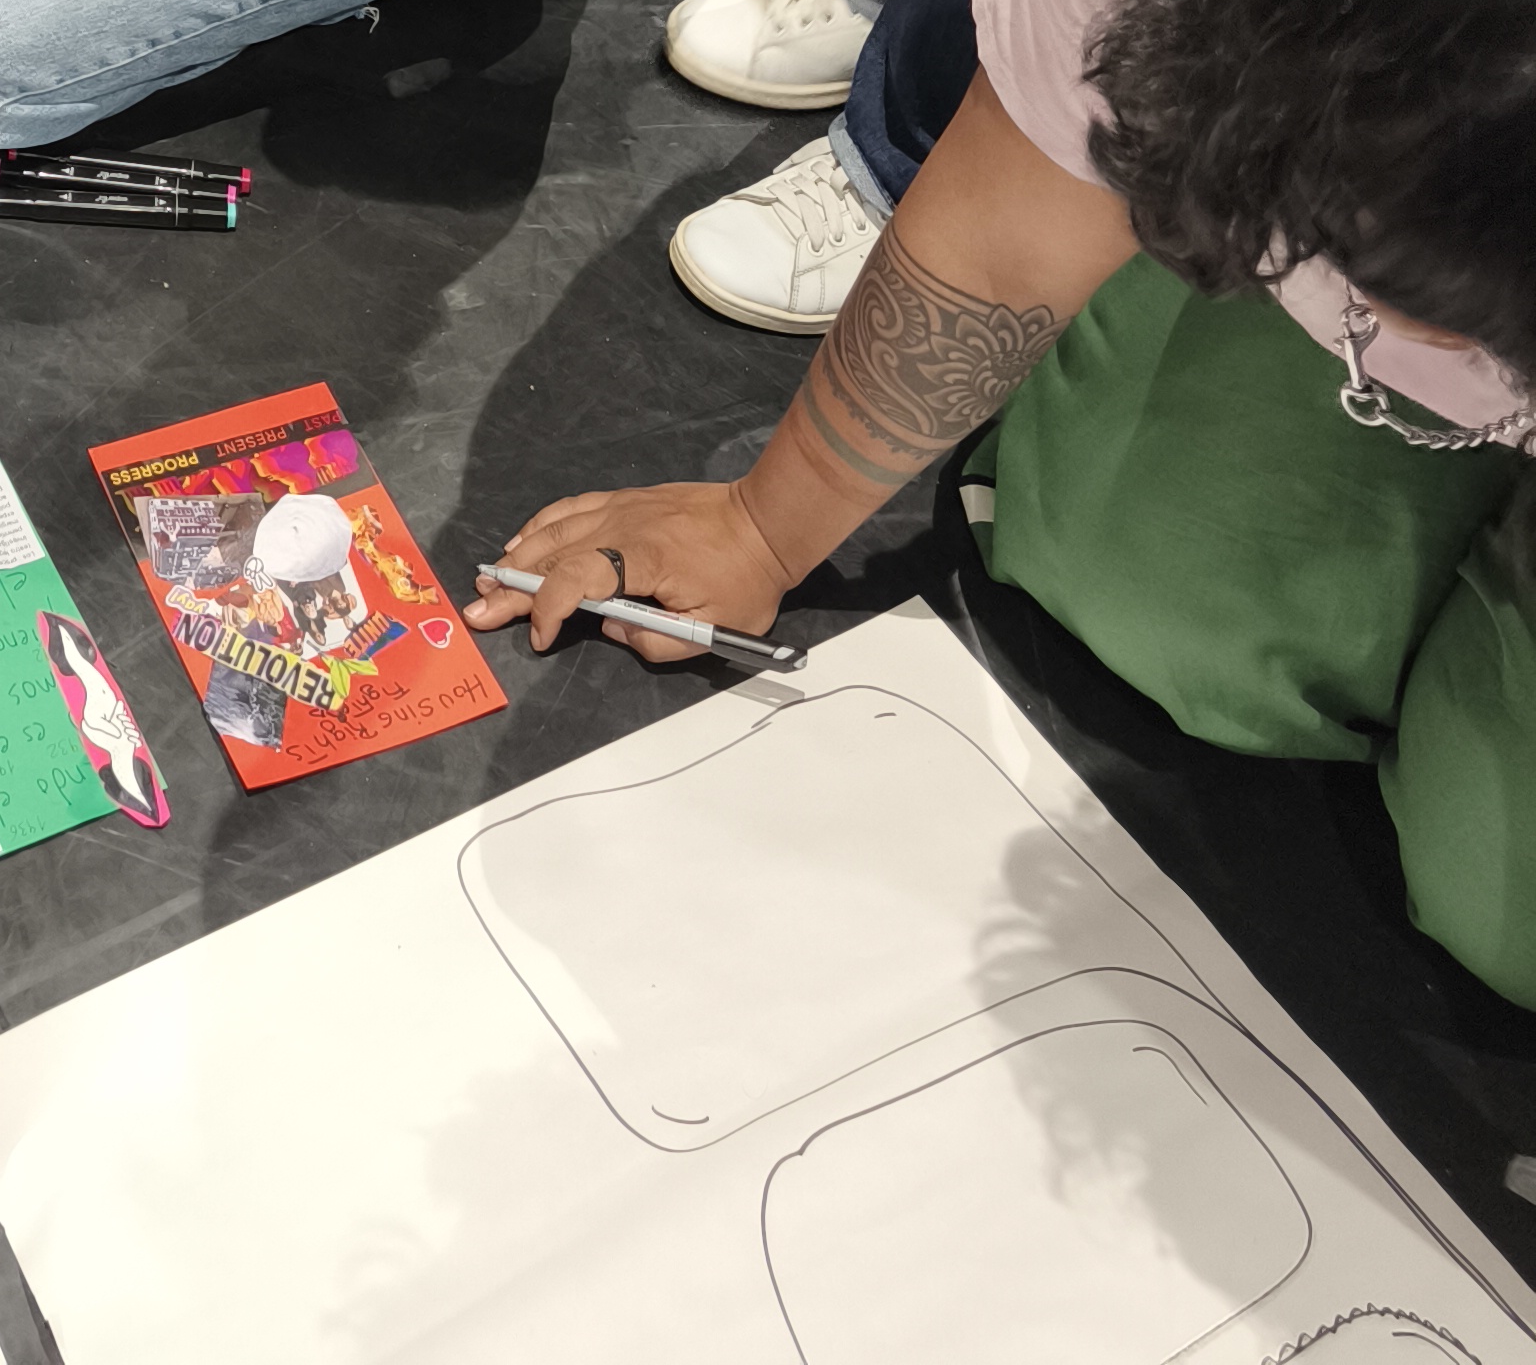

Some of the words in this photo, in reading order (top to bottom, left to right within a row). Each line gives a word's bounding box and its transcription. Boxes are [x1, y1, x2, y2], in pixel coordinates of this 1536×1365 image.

[301, 409, 342, 431] PAST
[214, 426, 287, 457] PRESENT
[109, 450, 199, 486] PROGRESS
[344, 612, 389, 658] UNITE
[174, 615, 335, 710] REVOLUTION
